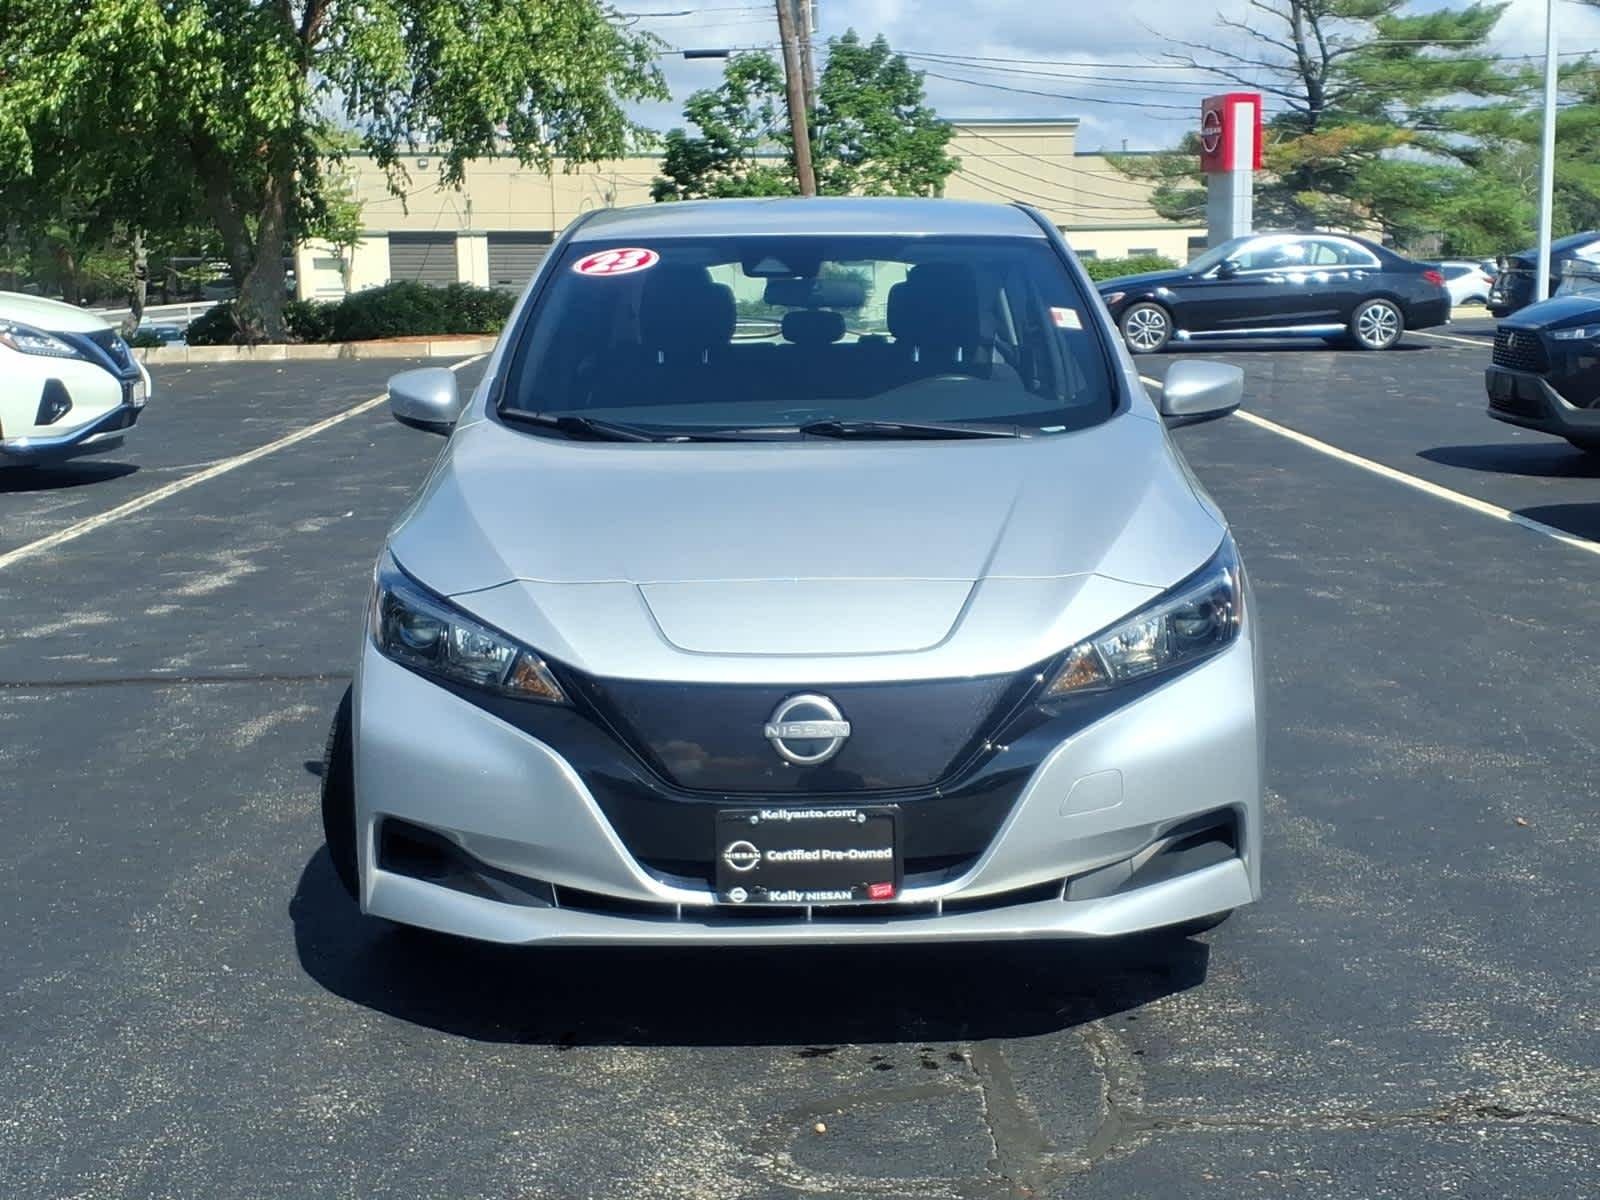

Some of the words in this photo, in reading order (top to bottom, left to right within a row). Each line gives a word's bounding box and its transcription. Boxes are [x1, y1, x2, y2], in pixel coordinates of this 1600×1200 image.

[583, 250, 648, 273] 23
[766, 725, 849, 737] NISSAN
[761, 808, 857, 820] Kellyauto.com
[767, 848, 819, 861] Certified
[822, 848, 893, 860] Pre-Owned
[769, 890, 804, 901] Kelly
[806, 890, 852, 900] NISSAN
